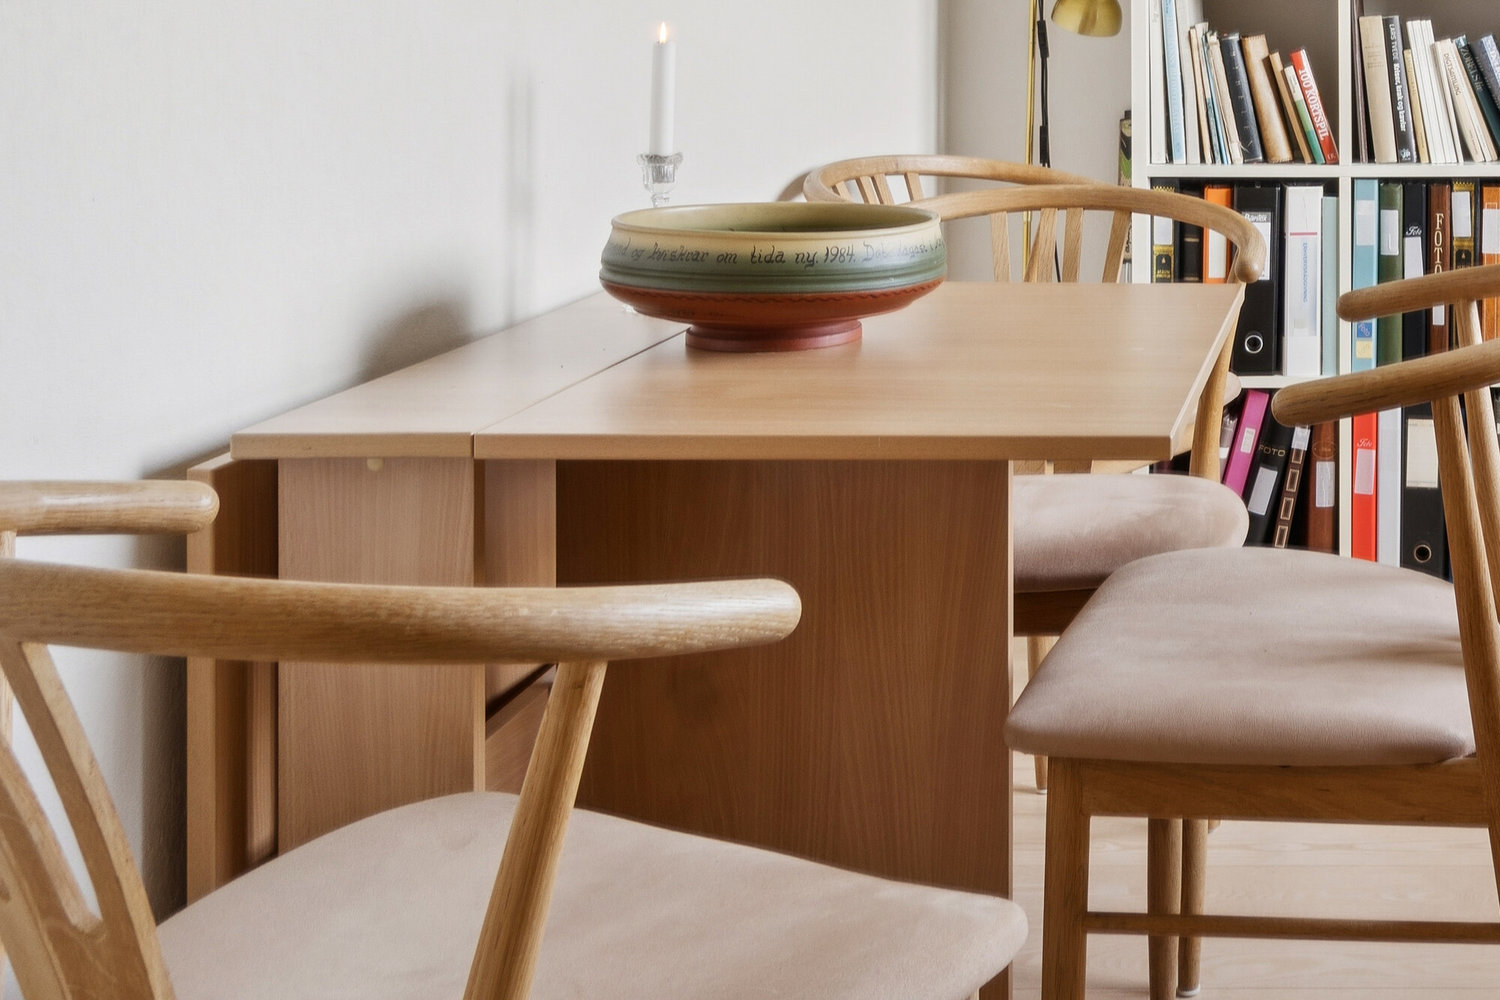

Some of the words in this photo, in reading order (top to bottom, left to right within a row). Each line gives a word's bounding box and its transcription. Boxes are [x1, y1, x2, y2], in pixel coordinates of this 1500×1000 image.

[1389, 23, 1398, 41] LARS
[1391, 40, 1400, 61] TVEDE
[1298, 68, 1312, 88] 100
[1305, 87, 1330, 141] KORTSPIL
[1244, 213, 1268, 223] Bantex
[1405, 225, 1422, 236] Foto
[716, 251, 738, 264] om
[750, 245, 786, 264] tida
[1356, 438, 1373, 448] Foto
[1257, 445, 1286, 457] FOTO
